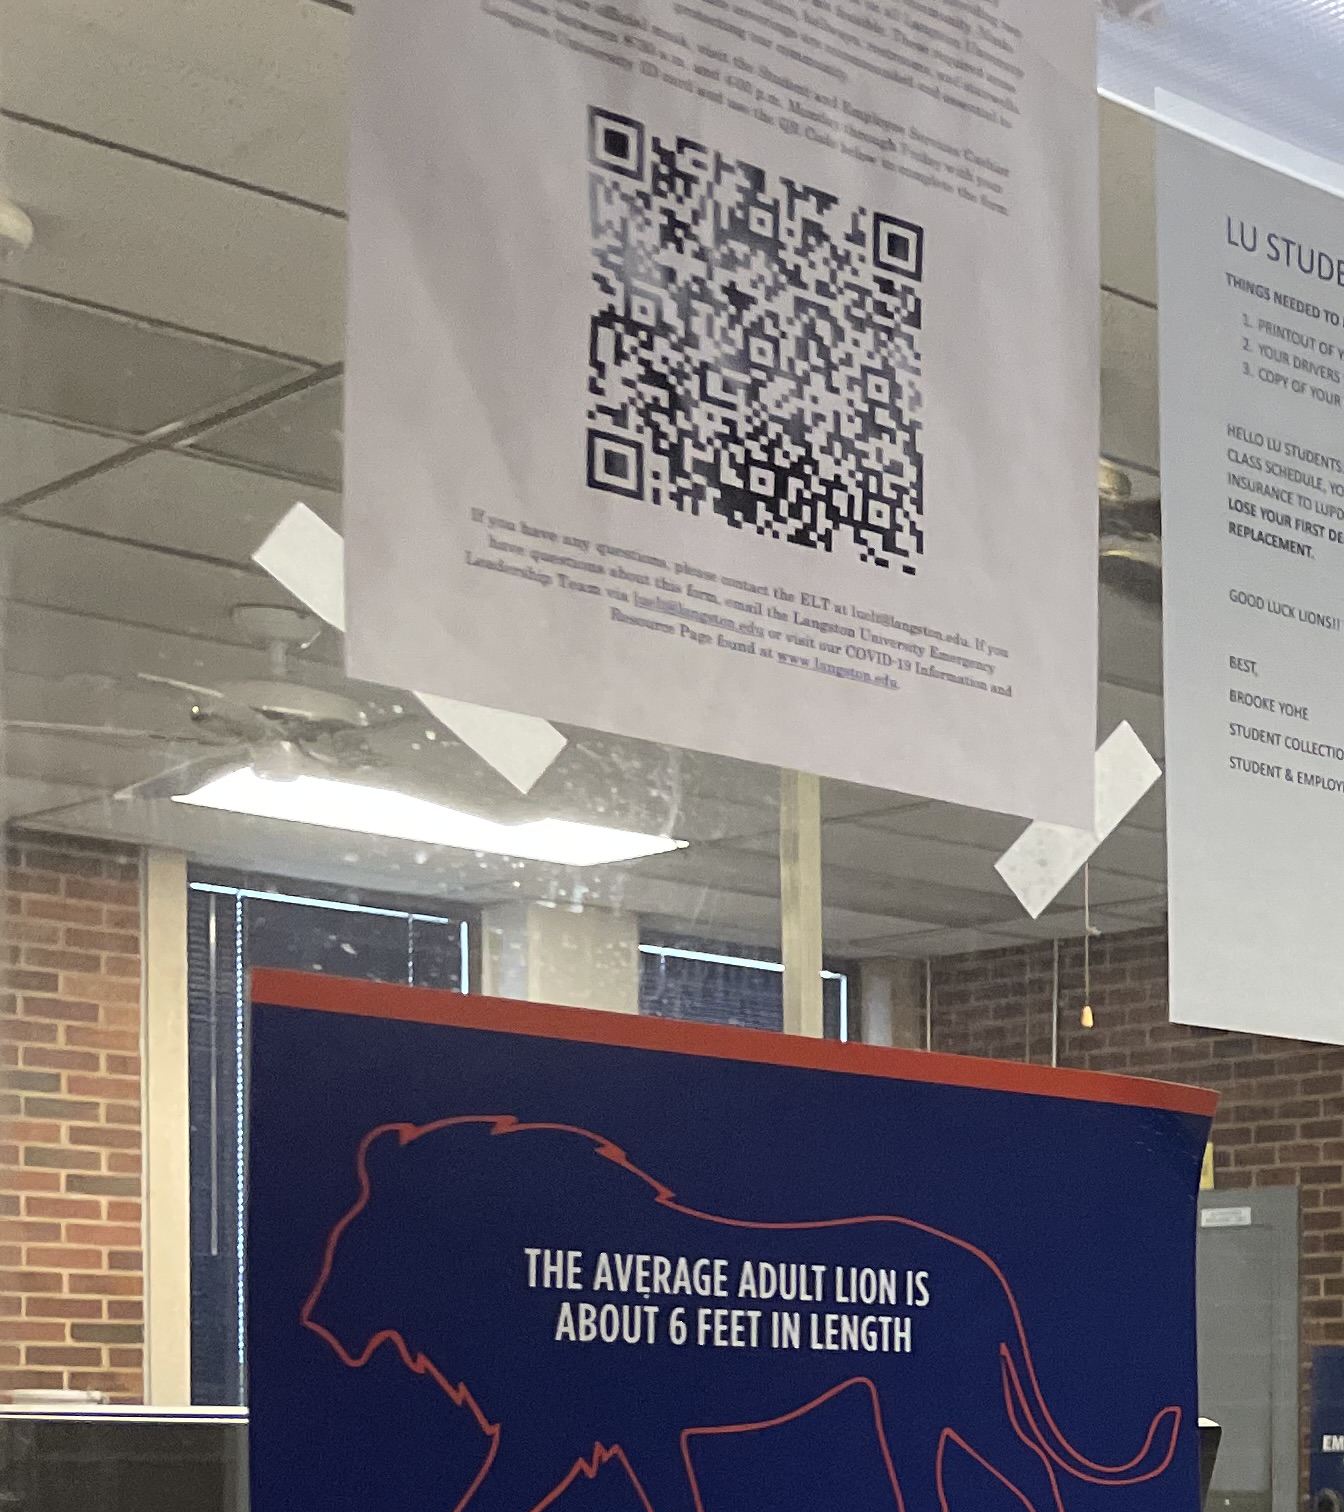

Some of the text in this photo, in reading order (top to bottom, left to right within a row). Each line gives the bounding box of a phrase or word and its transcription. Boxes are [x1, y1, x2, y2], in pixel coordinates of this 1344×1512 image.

[1227, 216, 1256, 252] LU
[1225, 272, 1270, 300] THINGS
[1273, 291, 1320, 318] NEEDED
[1258, 318, 1316, 352] PRINTOUT
[1258, 343, 1289, 365] YOUR
[1292, 354, 1340, 383] DRIVERS
[1258, 367, 1288, 388] COPY
[1309, 385, 1343, 408] YOUR
[1226, 423, 1264, 447] HELLO
[1227, 496, 1256, 517] LOSE
[1260, 506, 1291, 528] YOUR
[1294, 517, 1325, 537] FIRST
[1229, 688, 1275, 712] BROOKE
[1229, 722, 1280, 745] STUDENT
[1227, 755, 1281, 778] STUDENT
[525, 1248, 929, 1306] THE AVERAGE ADULT LION IS
[555, 1302, 911, 1352] ABOUT 6 FEET IN LENGTH
